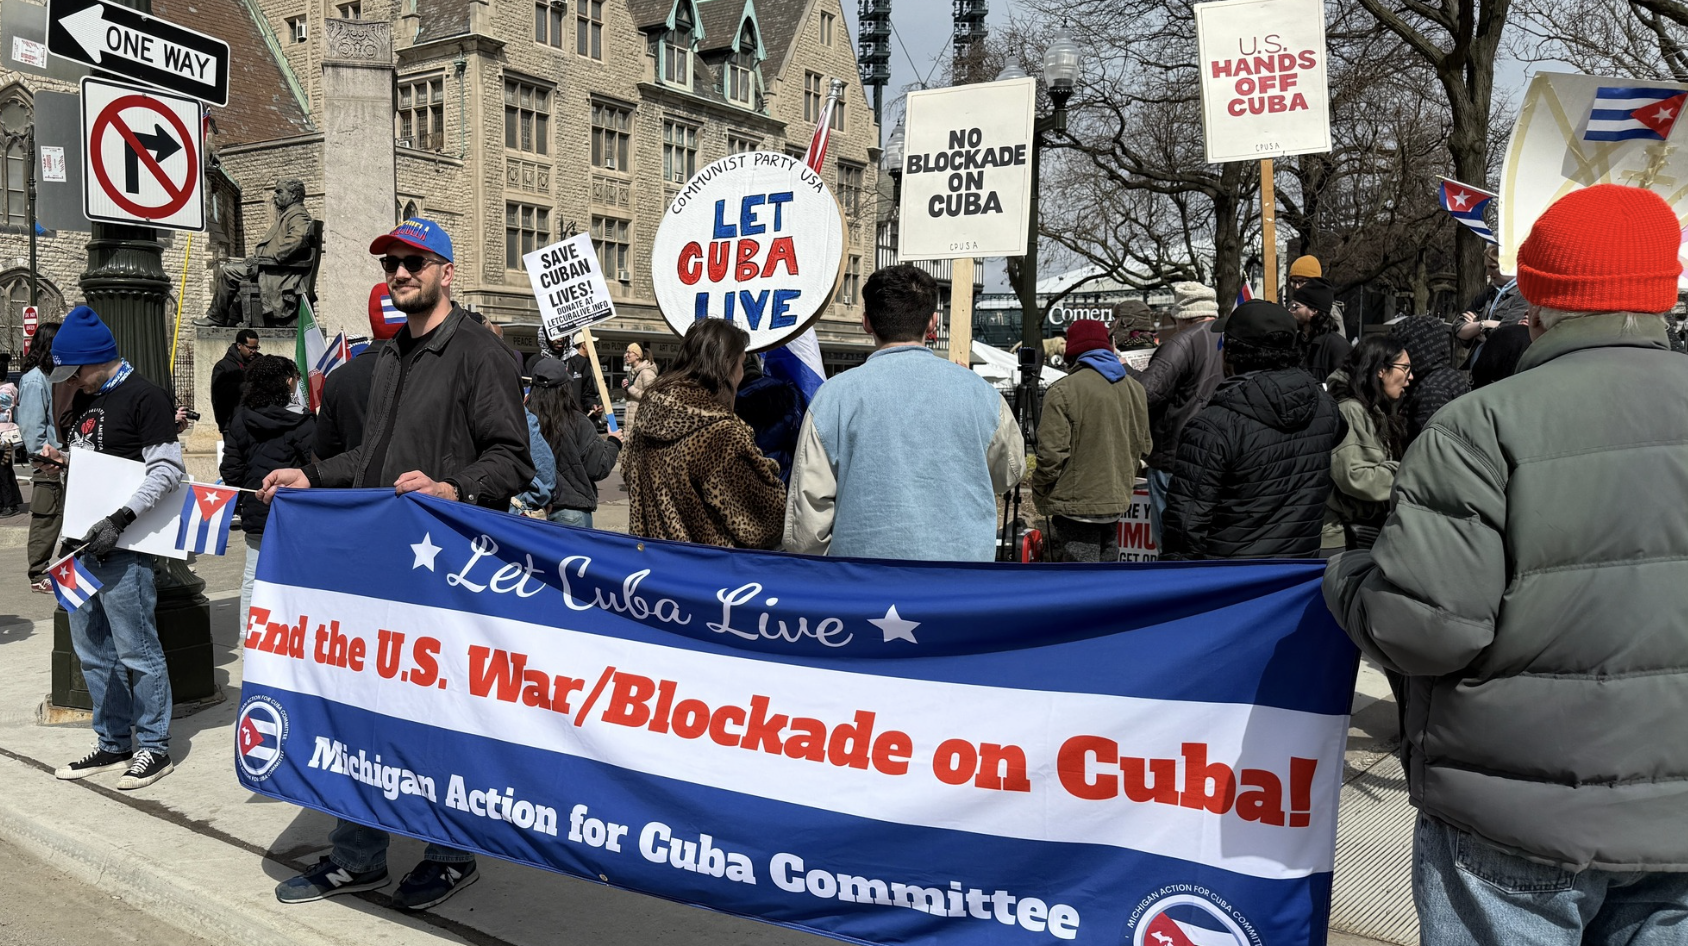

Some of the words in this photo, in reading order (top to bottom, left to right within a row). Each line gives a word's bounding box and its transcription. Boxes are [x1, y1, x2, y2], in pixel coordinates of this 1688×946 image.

[106, 26, 154, 64] ONE
[164, 43, 210, 80] WAY
[1239, 34, 1288, 56] U.S.
[1211, 50, 1316, 78] HANDS
[1234, 72, 1298, 96] OFF
[1227, 92, 1309, 117] CUBA
[948, 128, 982, 150] NO
[1255, 142, 1280, 152] CPUSA
[906, 144, 1026, 174] BLOCKADE
[672, 155, 746, 215] COMMUNIST
[754, 152, 798, 171] PARTY
[800, 168, 824, 194] USA
[948, 170, 984, 192] ON
[712, 191, 794, 240] LET
[928, 191, 1003, 218] CUBA
[540, 242, 579, 269] SAVE
[950, 241, 978, 251] CPUSA
[540, 258, 591, 288] CUBAN
[677, 236, 799, 286] CUBA
[548, 280, 594, 308] LIVES!
[556, 300, 584, 316] DONATE
[585, 296, 594, 306] AT
[547, 300, 609, 328] LETCUBALIVE.INFO
[694, 288, 802, 330] LIVE
[1048, 306, 1115, 324] Comeri
[513, 337, 532, 346] PEACE
[1121, 503, 1140, 519] RE
[446, 533, 547, 598] Let
[558, 554, 692, 626] Cuba
[706, 582, 854, 648] Live
[244, 606, 308, 660] End
[314, 620, 366, 672] the
[376, 628, 448, 690] U.S.
[468, 644, 914, 776] War/Blockade
[932, 736, 1032, 793] on
[1056, 734, 1318, 828] Cuba!
[307, 736, 436, 800] Michigan
[445, 774, 558, 837] Action
[568, 804, 628, 853] for
[638, 820, 757, 886] Cuba
[770, 852, 1080, 940] Committee
[325, 868, 353, 888] N
[1127, 891, 1160, 929] MICHIGAN
[1160, 884, 1192, 896] ACTION
[1193, 885, 1210, 897] FOR
[1210, 892, 1232, 913] CUBA
[1233, 911, 1263, 946] COMMIT
